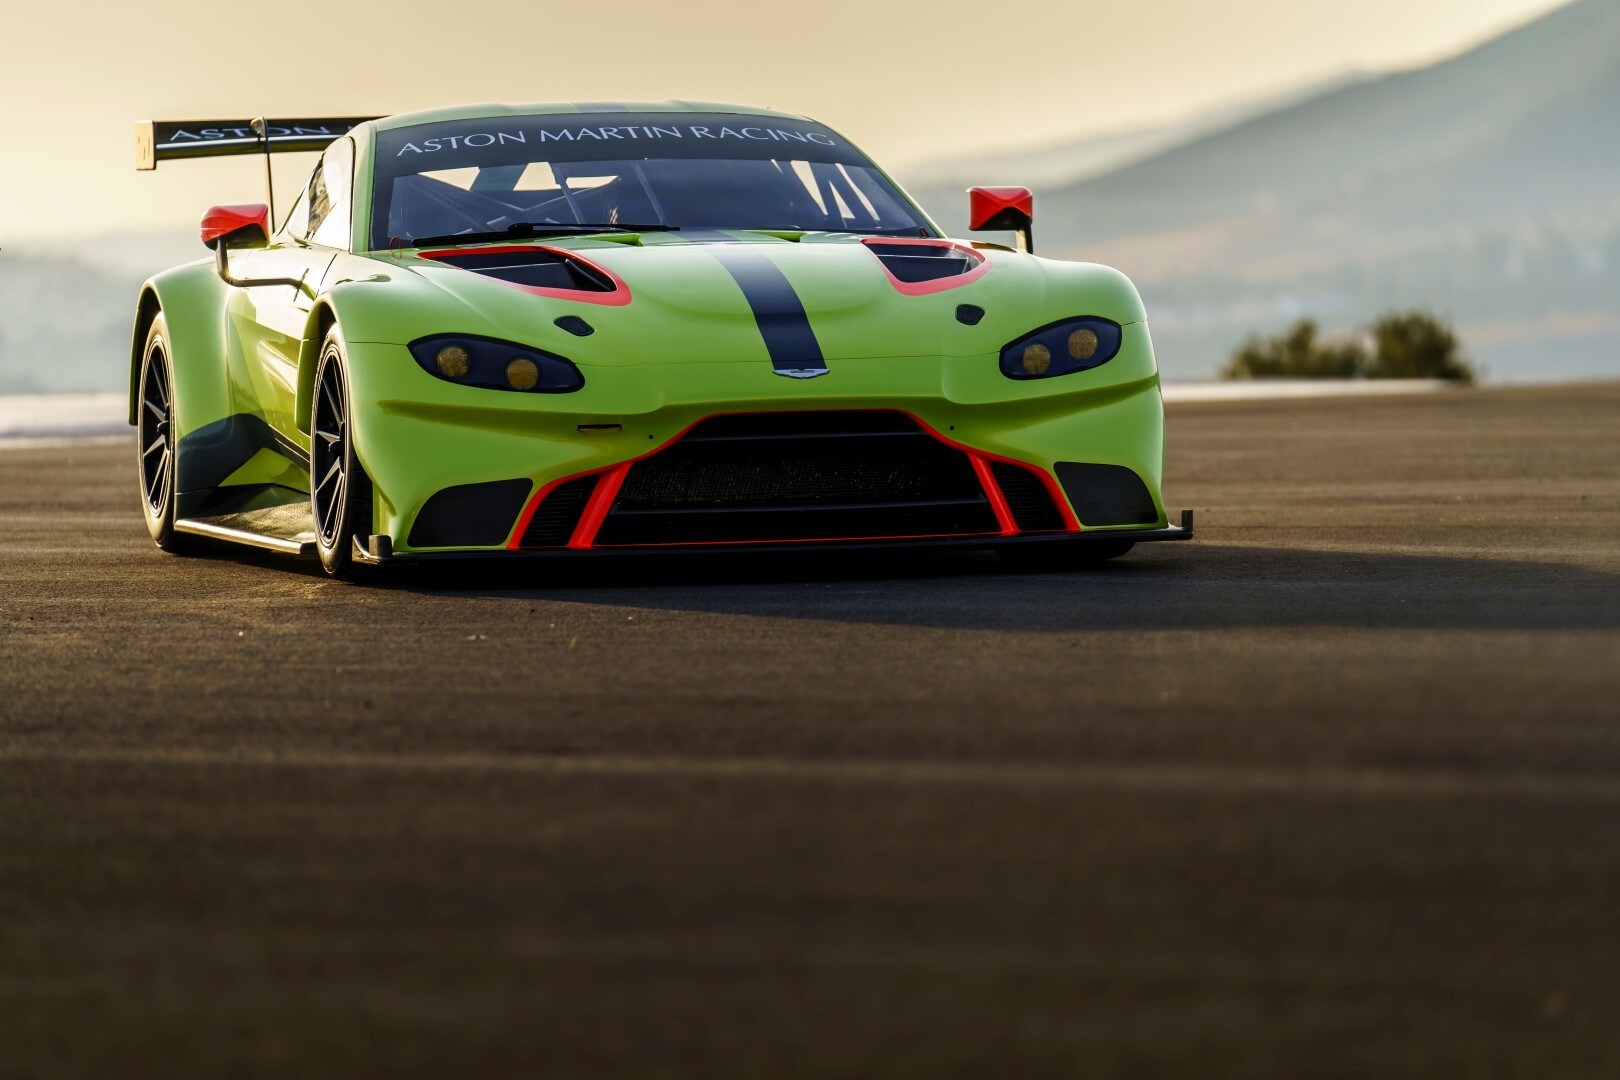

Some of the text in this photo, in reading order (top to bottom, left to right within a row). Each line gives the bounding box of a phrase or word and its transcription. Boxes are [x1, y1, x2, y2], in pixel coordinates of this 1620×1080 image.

[396, 126, 836, 156] ASTON MARTIN RACING
